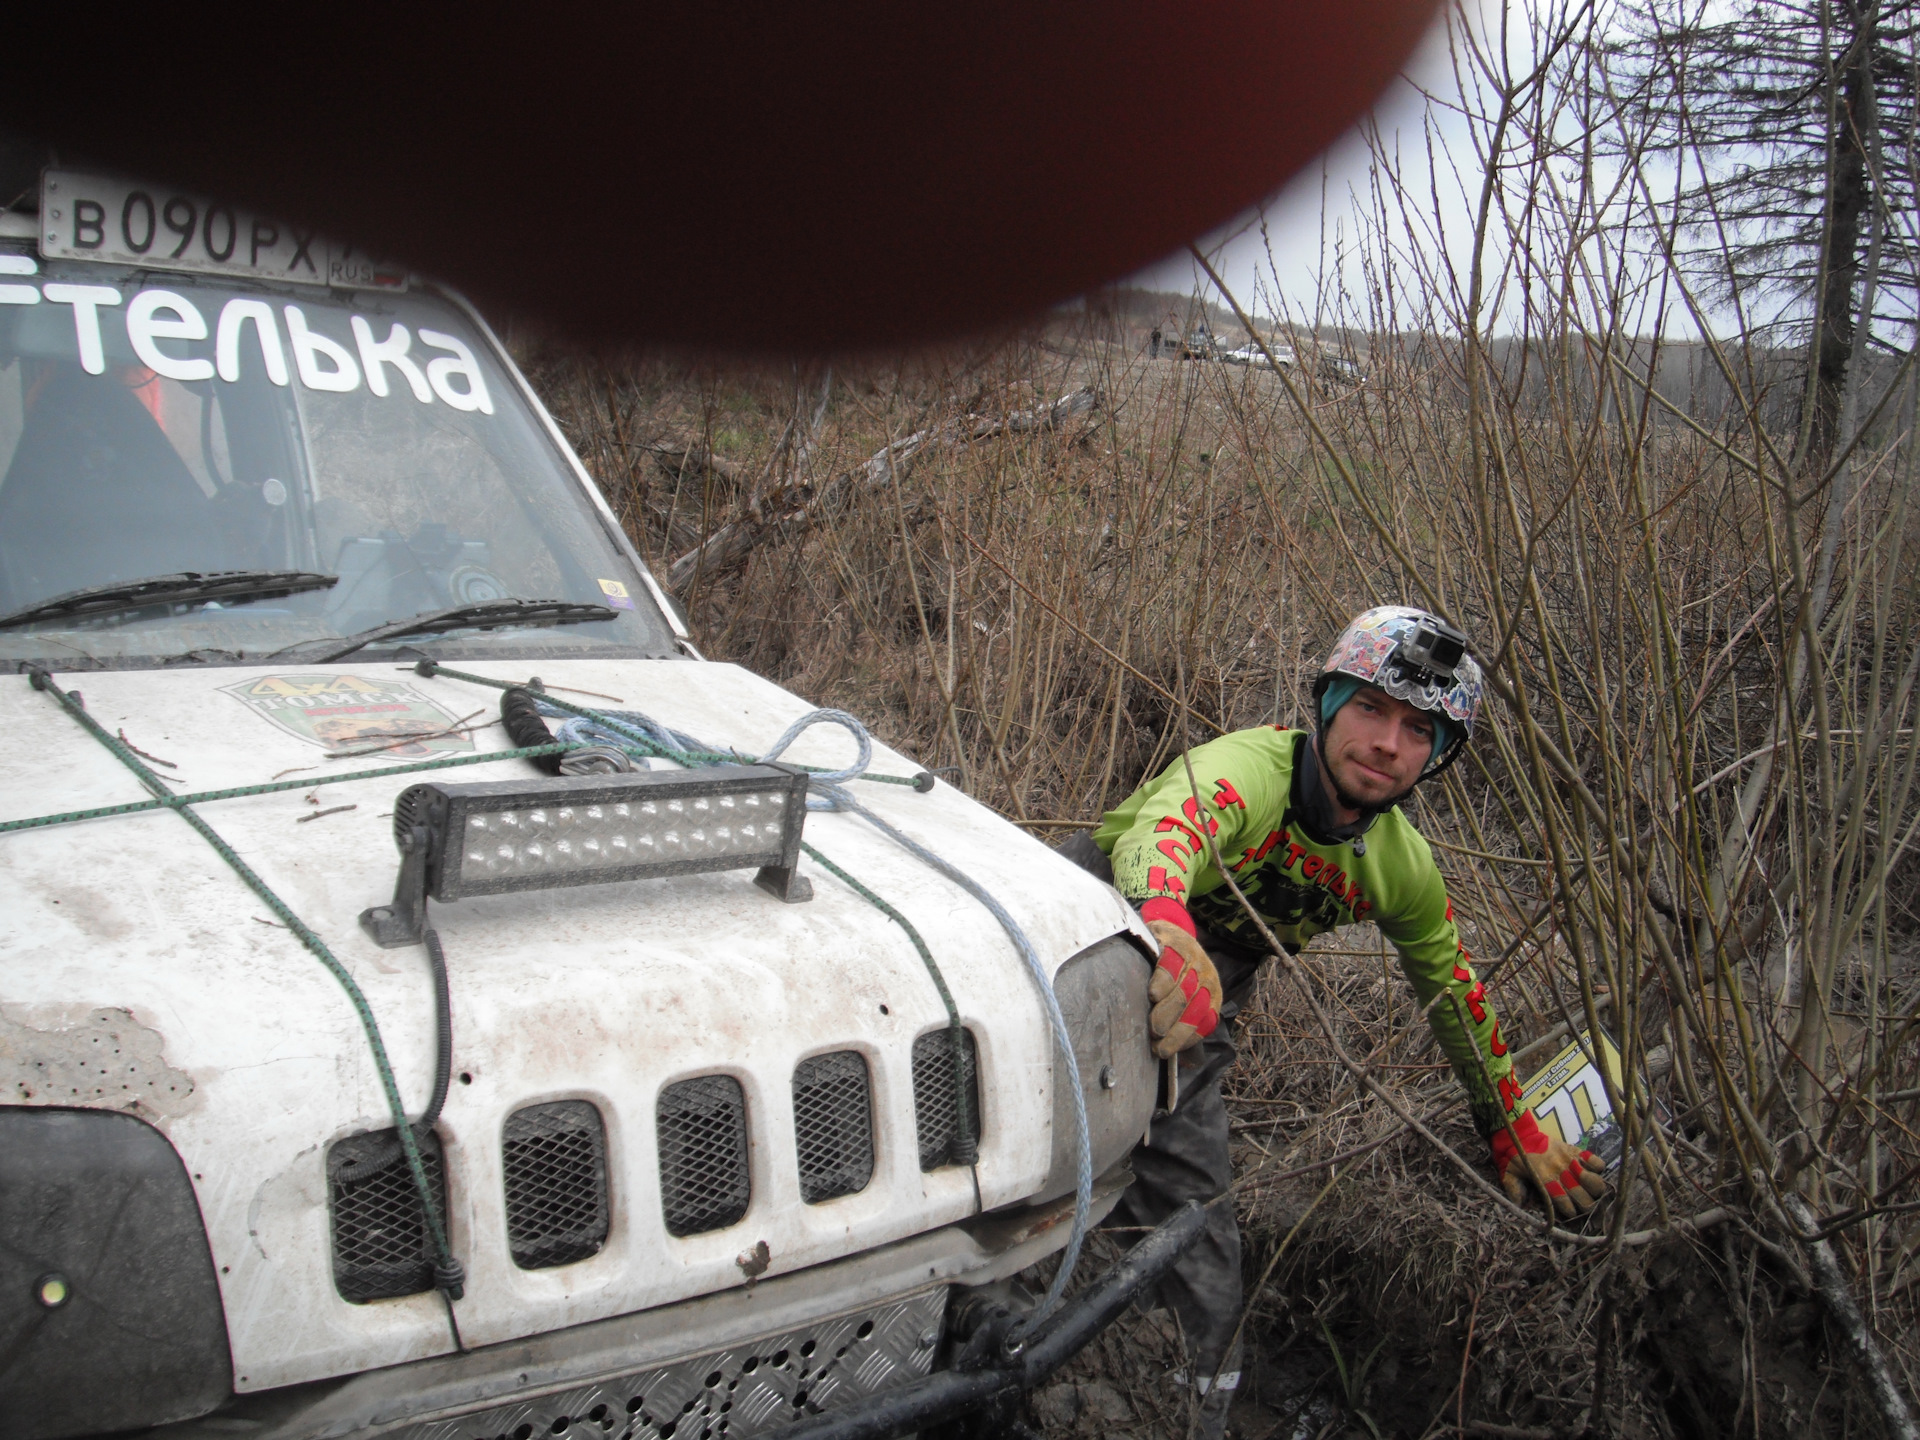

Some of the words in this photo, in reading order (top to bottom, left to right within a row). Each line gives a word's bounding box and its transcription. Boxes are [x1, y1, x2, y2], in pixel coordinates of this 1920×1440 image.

[331, 261, 372, 282] RUS
[246, 692, 430, 711] ТОМСК
[1550, 1048, 1576, 1075] Сибири
